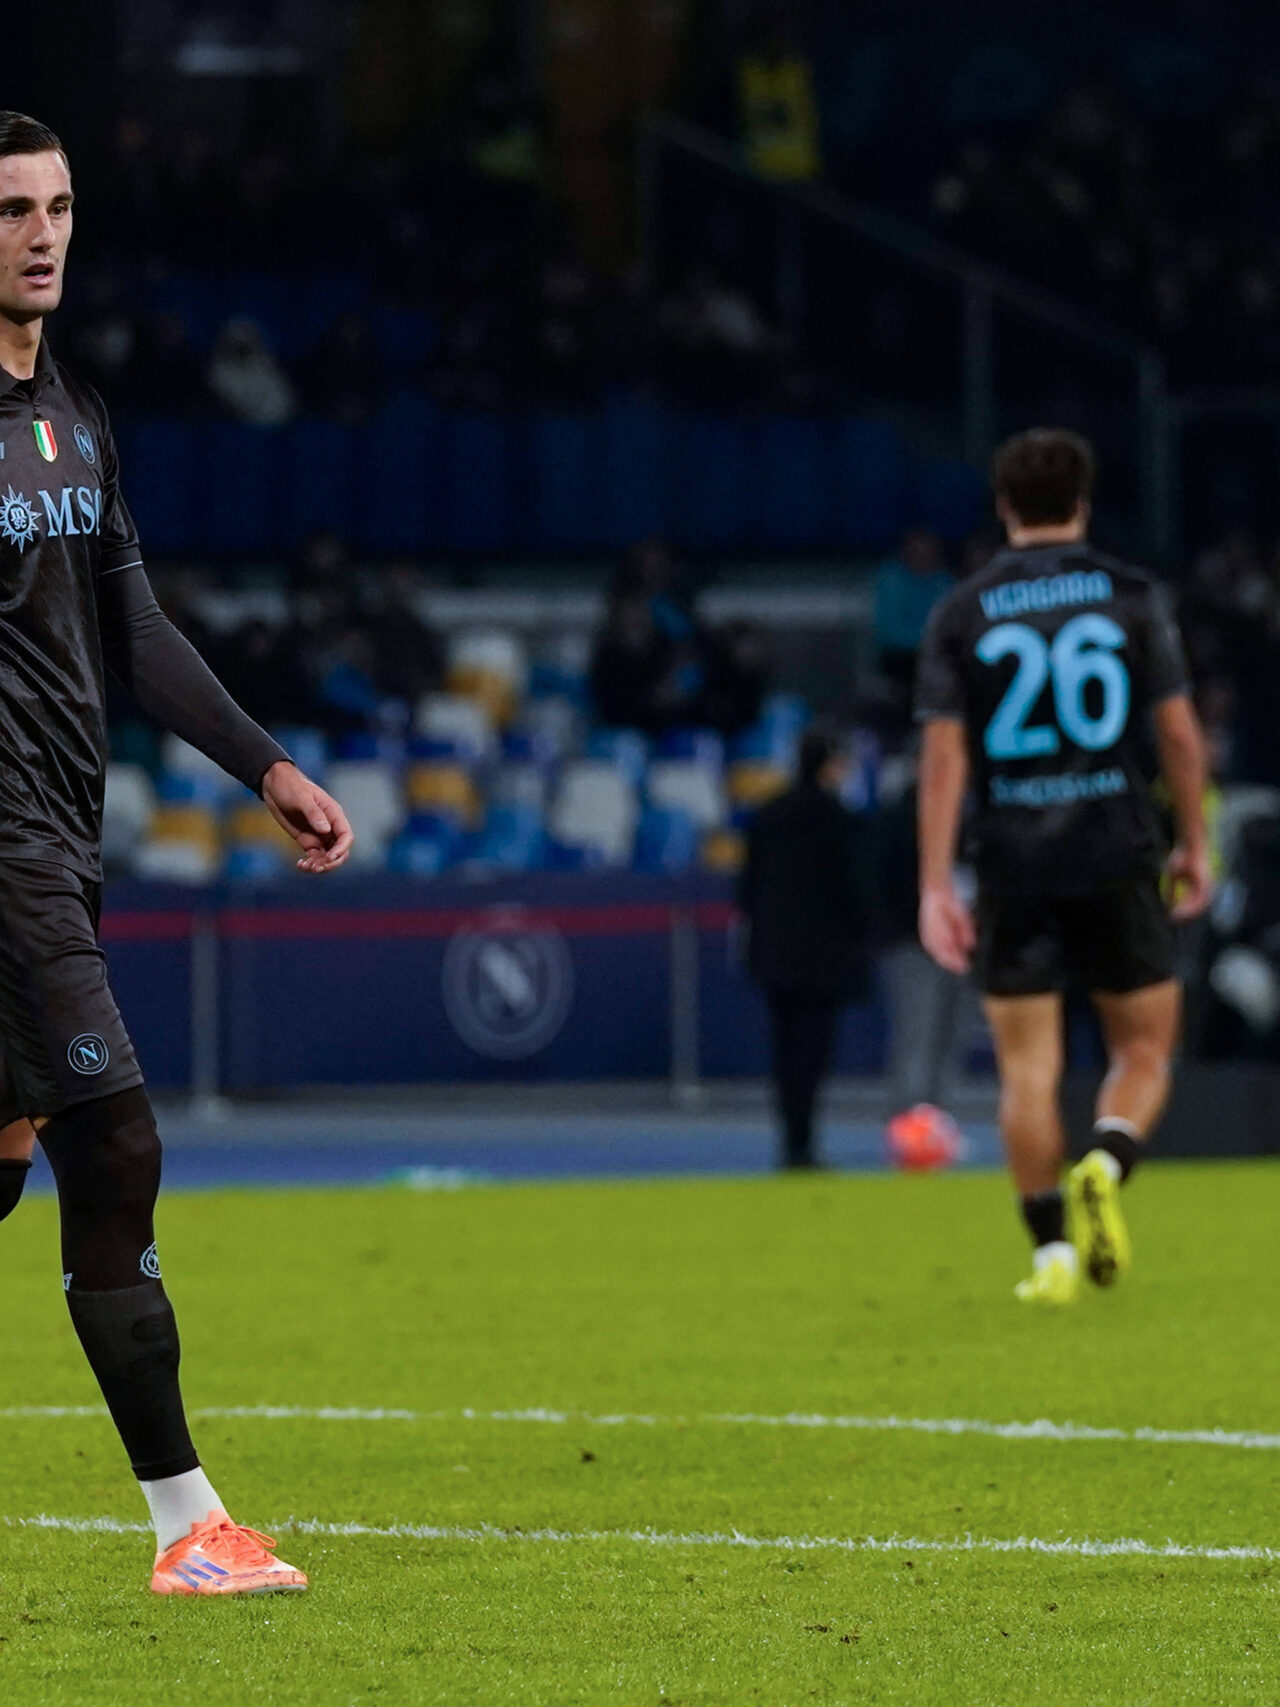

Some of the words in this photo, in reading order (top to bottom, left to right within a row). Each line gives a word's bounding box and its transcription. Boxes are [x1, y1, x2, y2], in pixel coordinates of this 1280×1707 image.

[980, 570, 1113, 621] VERGARA
[976, 613, 1130, 760] 26
[78, 1043, 99, 1065] N
